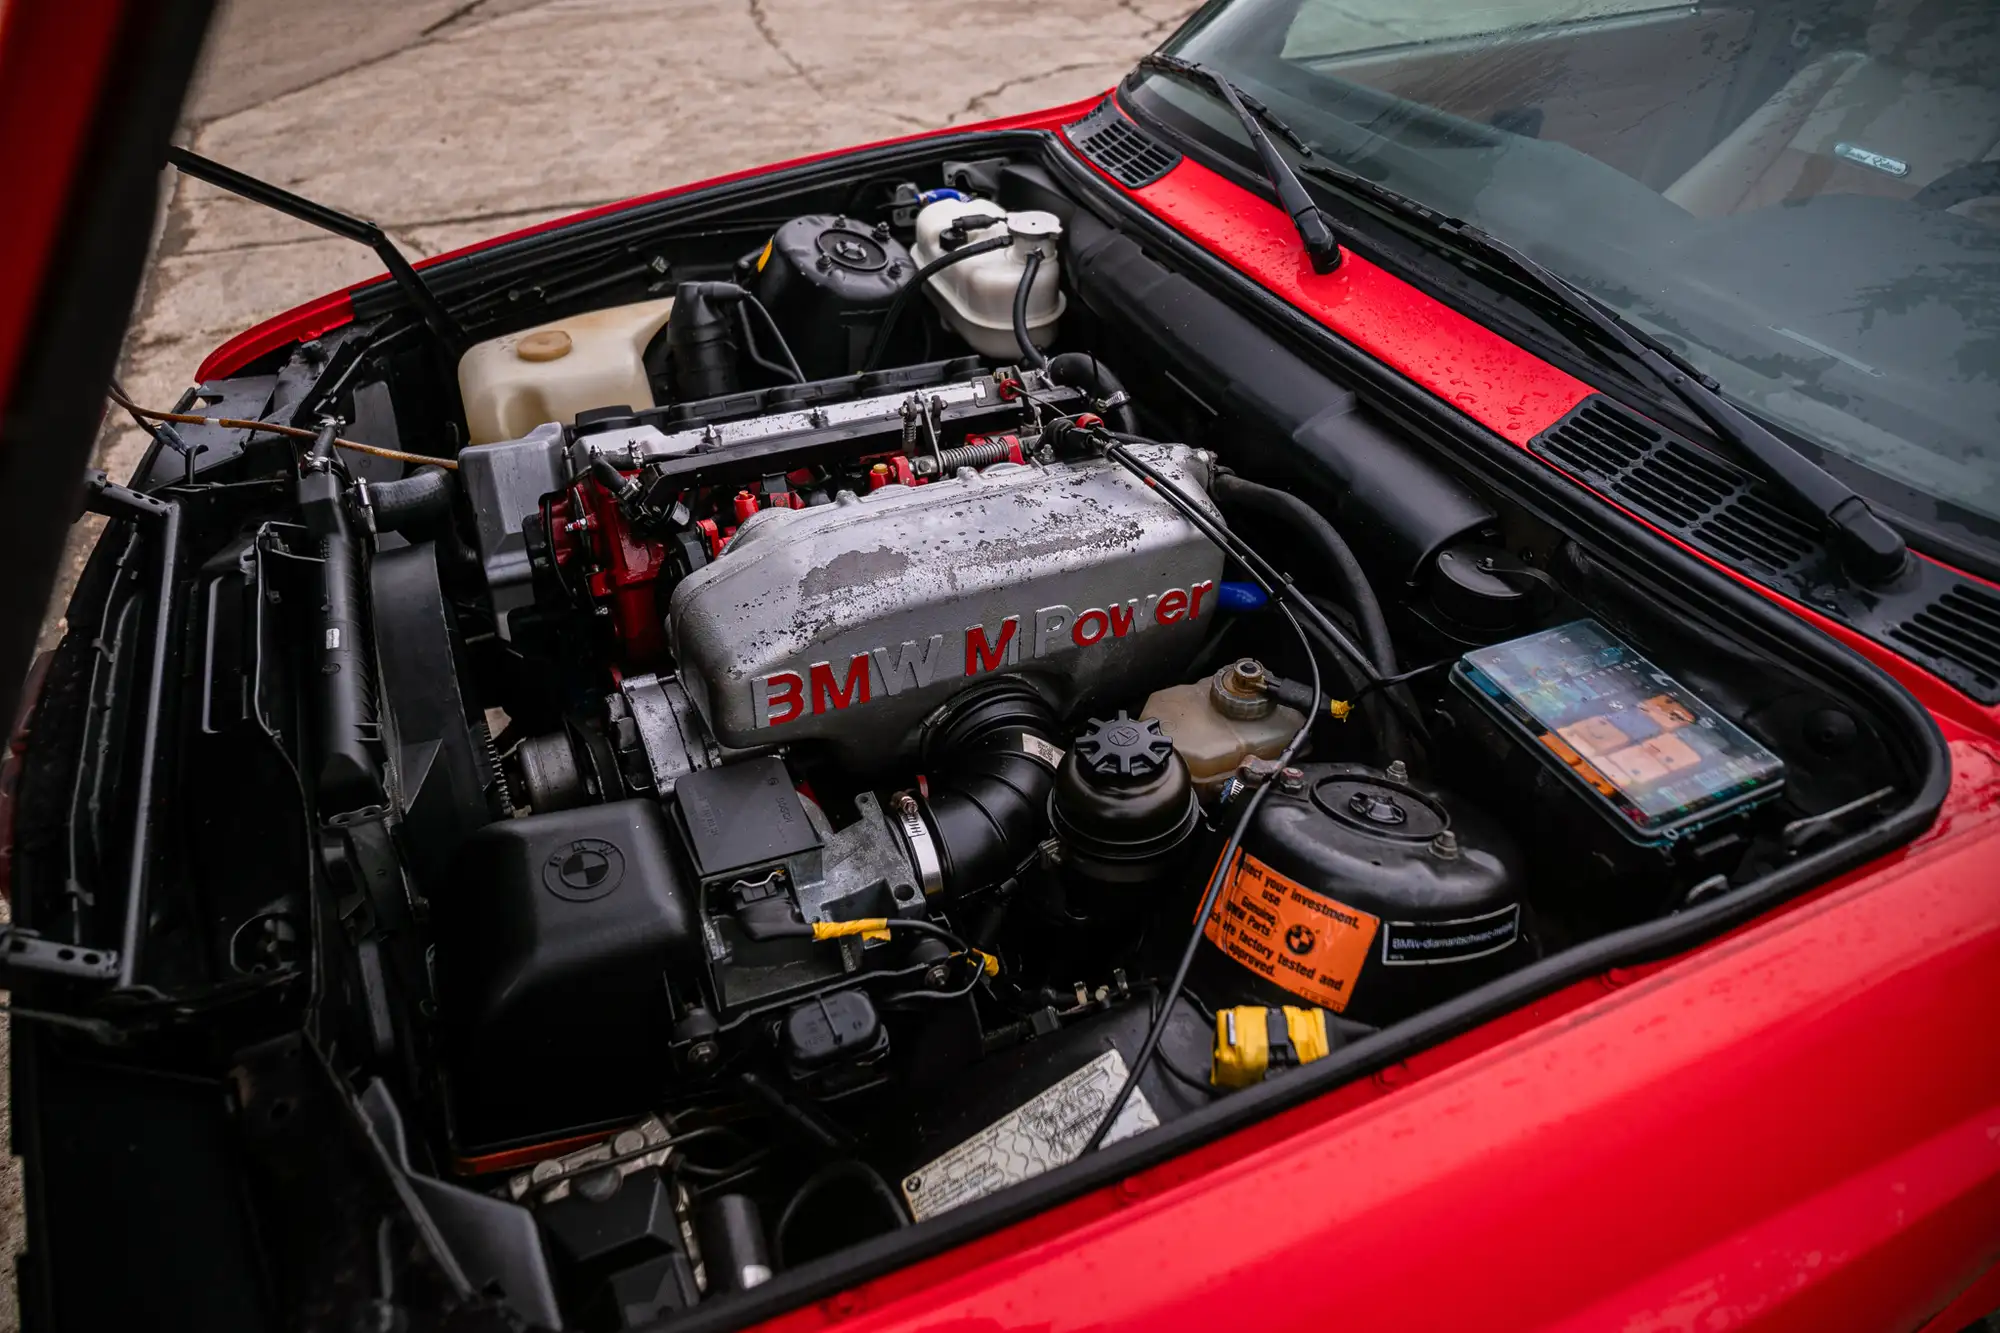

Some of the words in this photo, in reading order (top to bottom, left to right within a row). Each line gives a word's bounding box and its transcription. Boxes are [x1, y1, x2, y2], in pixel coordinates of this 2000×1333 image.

[751, 634, 943, 730] BMW
[965, 614, 1021, 677] M
[1033, 579, 1213, 659] Power
[549, 841, 617, 867] BMW
[1262, 889, 1281, 907] use
[1264, 876, 1288, 895] your
[1239, 929, 1274, 960] factory
[1278, 952, 1316, 980] tested
[1319, 974, 1344, 991] and
